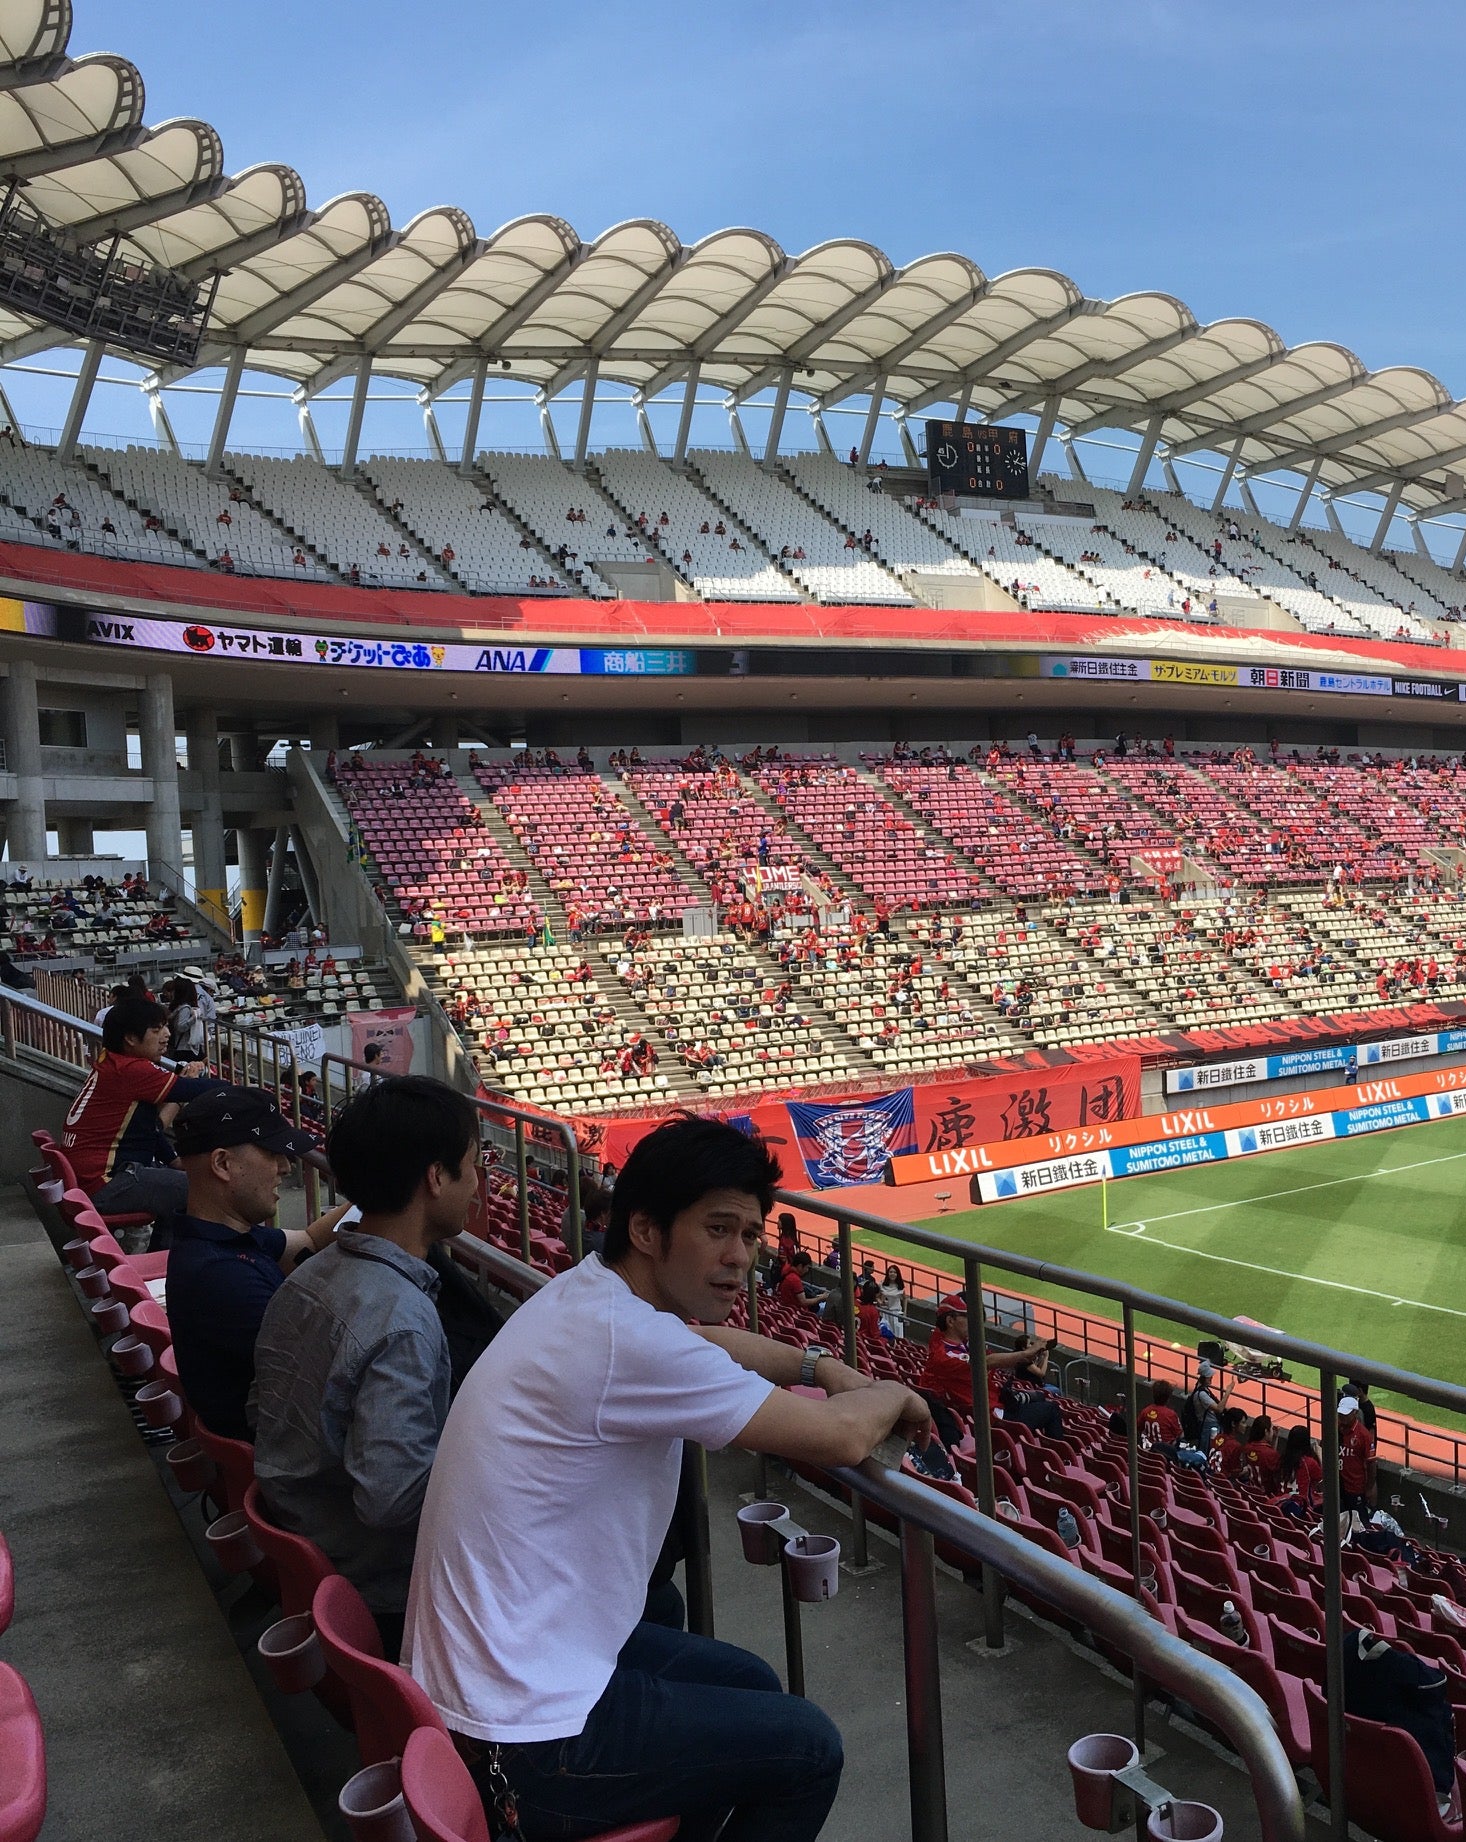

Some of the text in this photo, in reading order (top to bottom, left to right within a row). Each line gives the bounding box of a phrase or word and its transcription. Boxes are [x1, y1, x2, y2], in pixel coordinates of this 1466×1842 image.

[87, 620, 135, 641] AVIX
[217, 631, 303, 657] ヤマト運輸
[330, 641, 431, 668] チケットぴあ
[475, 650, 526, 671] ANA
[603, 651, 687, 673] 商船三井
[1250, 668, 1310, 689] 朝日新聞
[1319, 677, 1390, 692] 鹿島セントラルホテル
[1395, 681, 1443, 697] NIKE FOOTBALL
[1281, 1052, 1312, 1065] NIPPON
[1313, 1050, 1335, 1062] STEEL
[1381, 1039, 1430, 1059] 新日鐵住金
[1196, 1063, 1257, 1085] 新日鐵住金
[1278, 1060, 1347, 1076] SUMITOMO METAL
[1356, 1081, 1401, 1103] LIXIL
[1260, 1096, 1314, 1118] リクシル
[1161, 1111, 1214, 1135] LIXIL
[1259, 1119, 1323, 1146] 新日鐵住金
[1048, 1127, 1113, 1153] リクシル
[1129, 1142, 1167, 1160] NIPPON
[1168, 1139, 1199, 1154] STEEL
[928, 1147, 993, 1176] LIXIL
[1126, 1148, 1215, 1174] SUMITOMO METAL
[1021, 1158, 1099, 1189] 新日鐵住金
